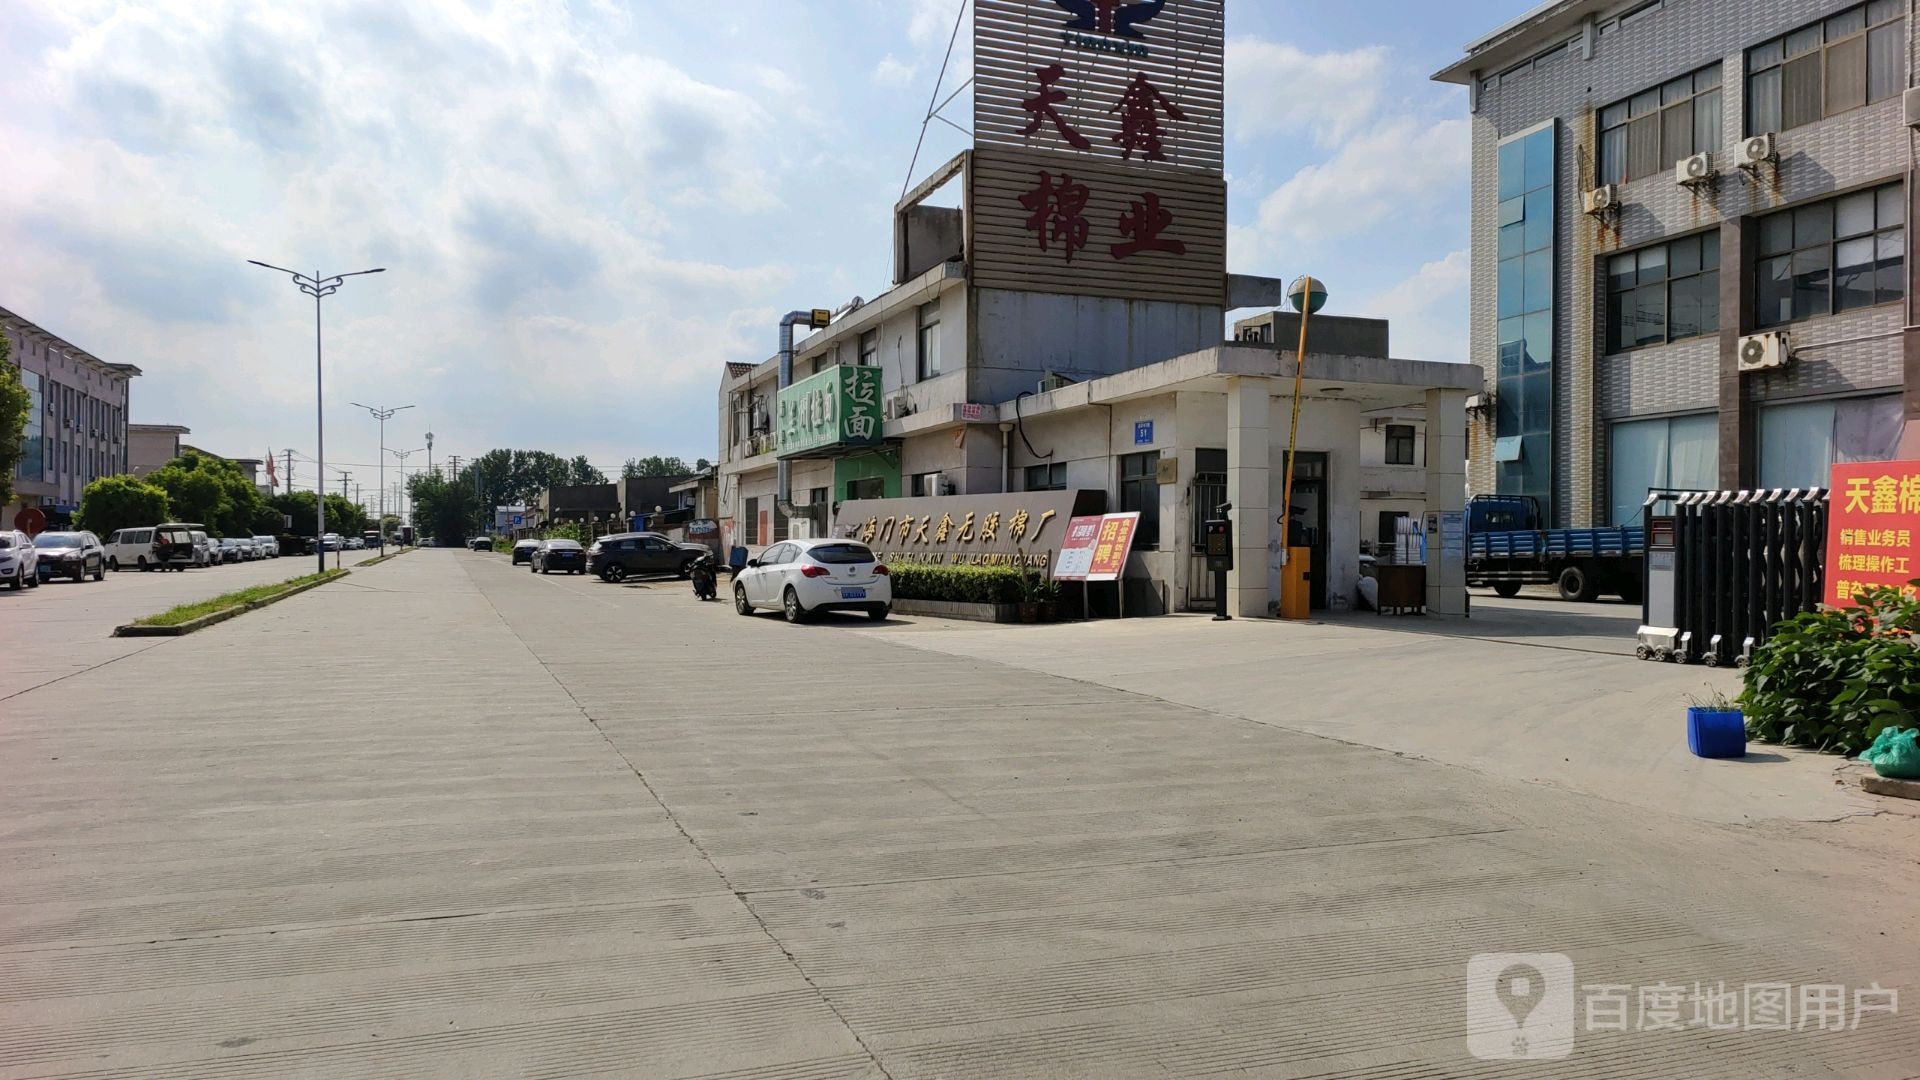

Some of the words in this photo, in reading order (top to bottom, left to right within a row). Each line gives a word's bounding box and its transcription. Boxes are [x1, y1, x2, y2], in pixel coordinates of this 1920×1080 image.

[1015, 63, 1189, 162] 天鑫
[1017, 170, 1186, 264] 棉业
[844, 367, 876, 440] 拉面
[1844, 475, 1920, 514] 天鑫棉
[860, 509, 1056, 545] 海门市天鑫无胶棉厂
[1094, 520, 1119, 564] 招聘
[1840, 528, 1911, 548] 销售业务员
[1839, 554, 1911, 574] 梳理操作工
